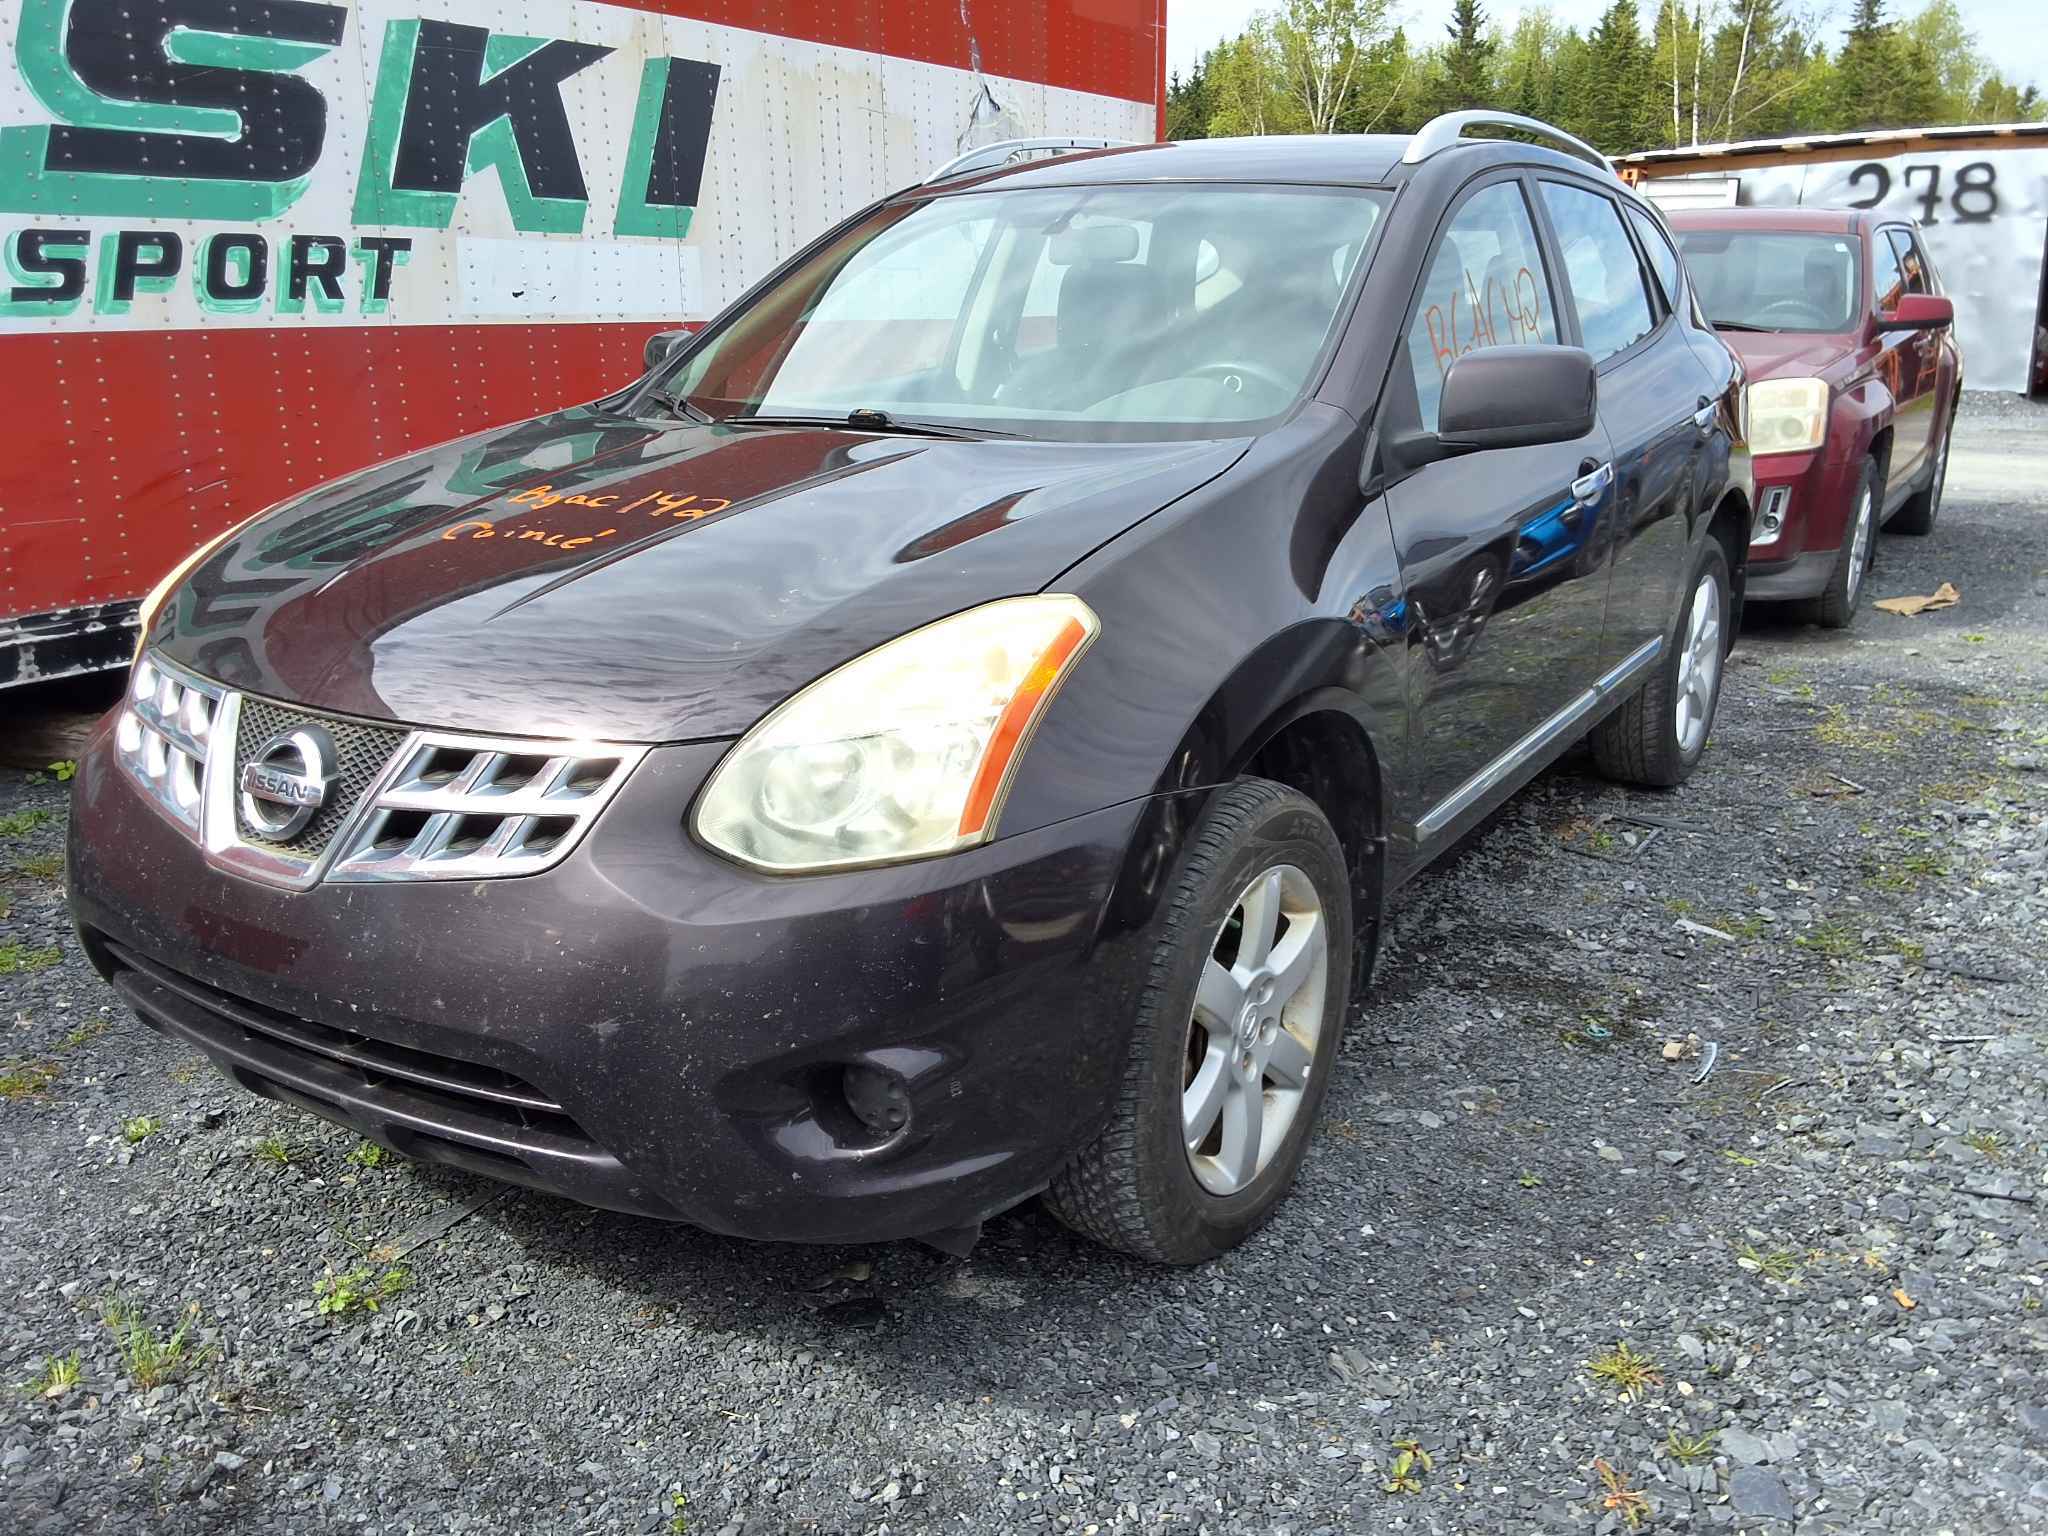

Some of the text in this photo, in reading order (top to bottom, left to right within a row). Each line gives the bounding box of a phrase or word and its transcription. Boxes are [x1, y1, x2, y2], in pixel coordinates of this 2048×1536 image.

[0, 0, 722, 238] SKI
[1848, 162, 1998, 226] 278
[0, 228, 413, 316] SPORT
[616, 490, 731, 521] 142
[244, 773, 308, 799] NISSAN
